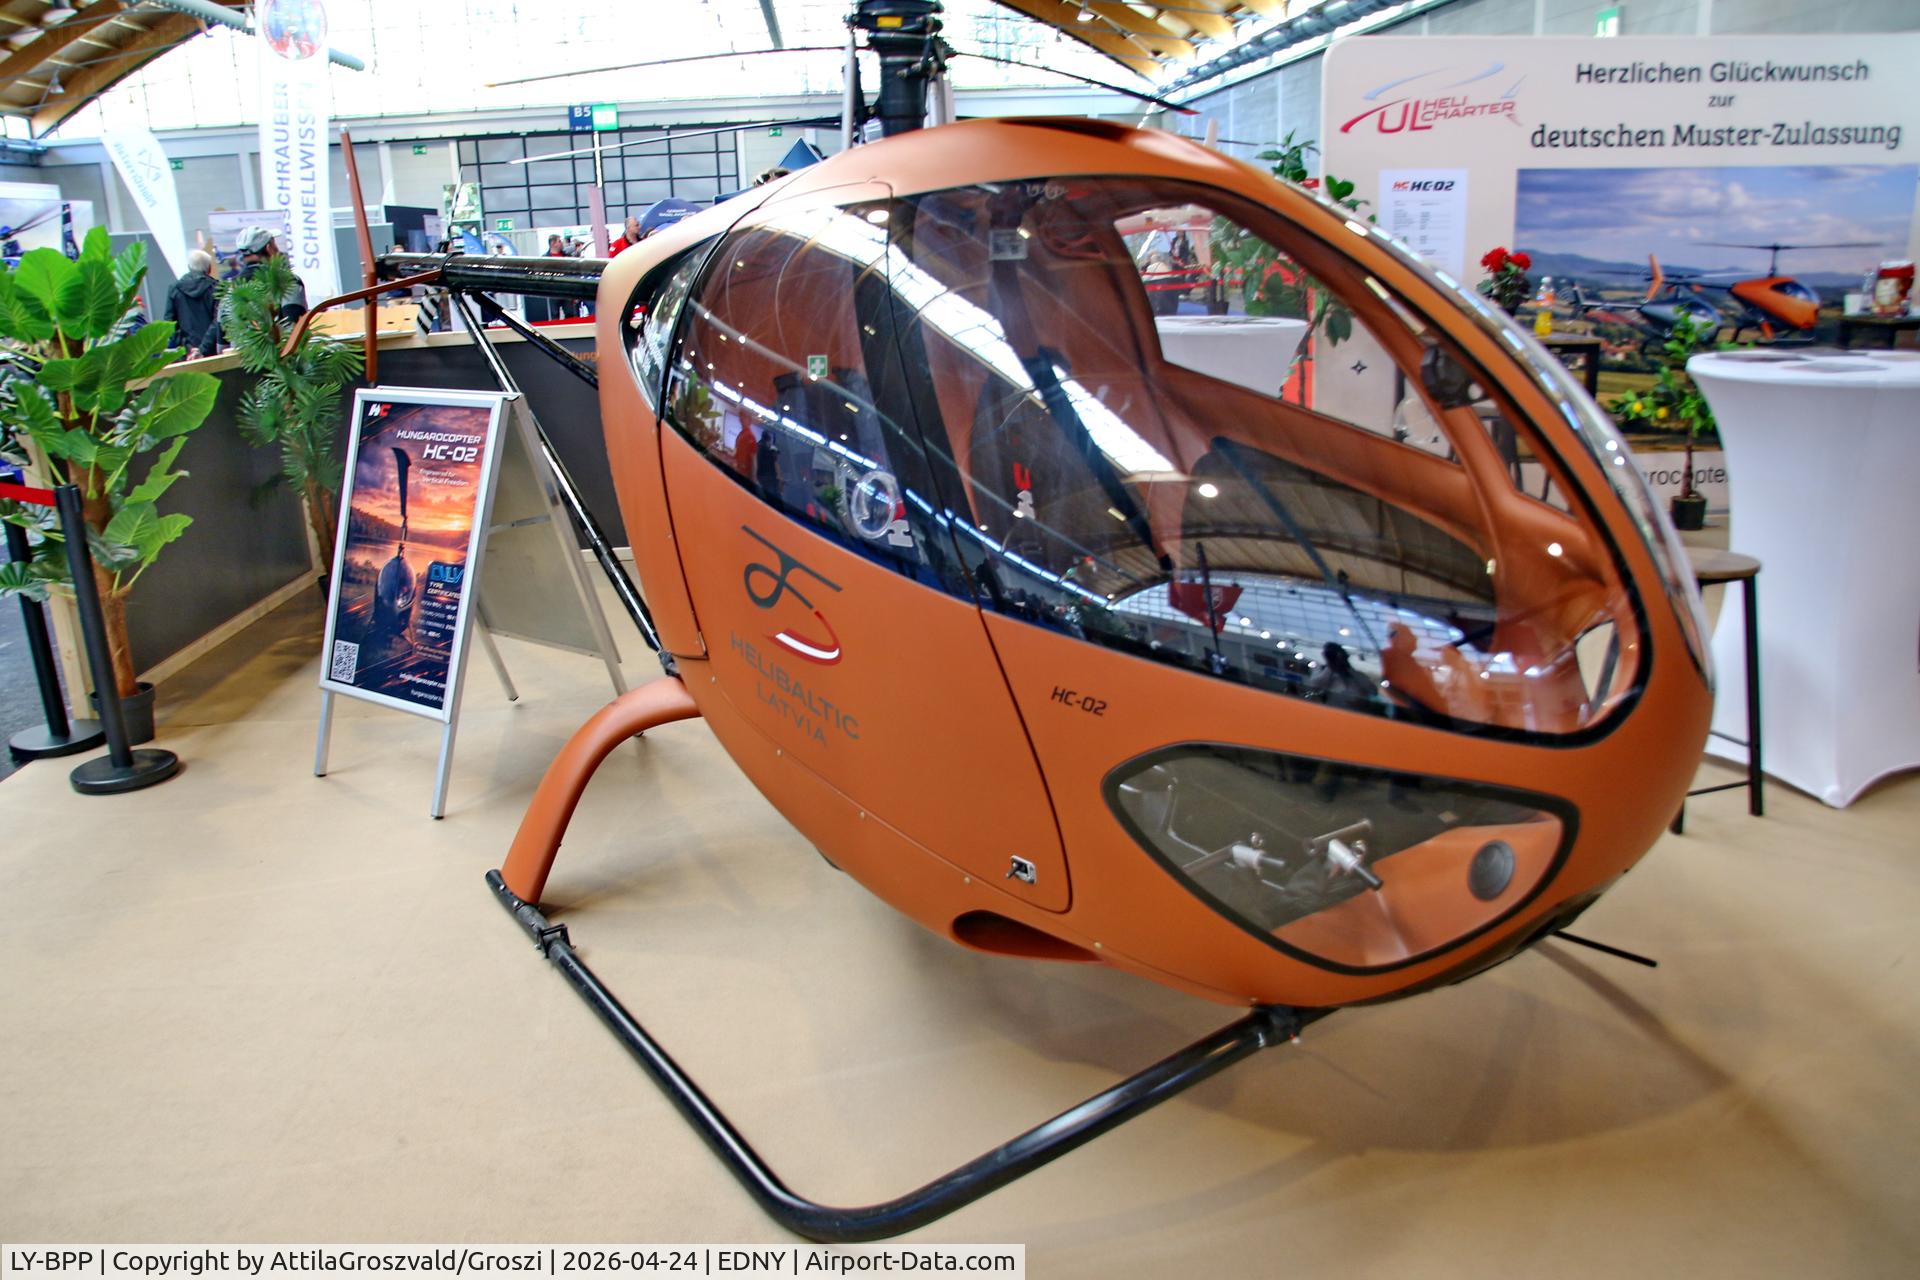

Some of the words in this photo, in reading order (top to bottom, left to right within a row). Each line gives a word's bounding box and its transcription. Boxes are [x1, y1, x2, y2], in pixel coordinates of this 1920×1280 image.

[1575, 62, 1701, 84] Herzlichen
[1709, 60, 1868, 83] Glückwunsch
[1420, 101, 1517, 122] CHARTER
[1708, 94, 1735, 107] zur
[573, 106, 592, 118] B5
[1377, 100, 1434, 134] UL
[1422, 96, 1469, 110] HELI
[1530, 123, 1665, 148] deutschen
[1671, 121, 1902, 150] Muster-Zulassung
[367, 403, 393, 417] HC
[396, 430, 482, 444] HUNGAROCOPTER
[422, 444, 478, 463] HC-02
[730, 630, 861, 740] HELIBALTIC
[1051, 686, 1107, 717] HC-02
[757, 682, 828, 747] LATVIA
